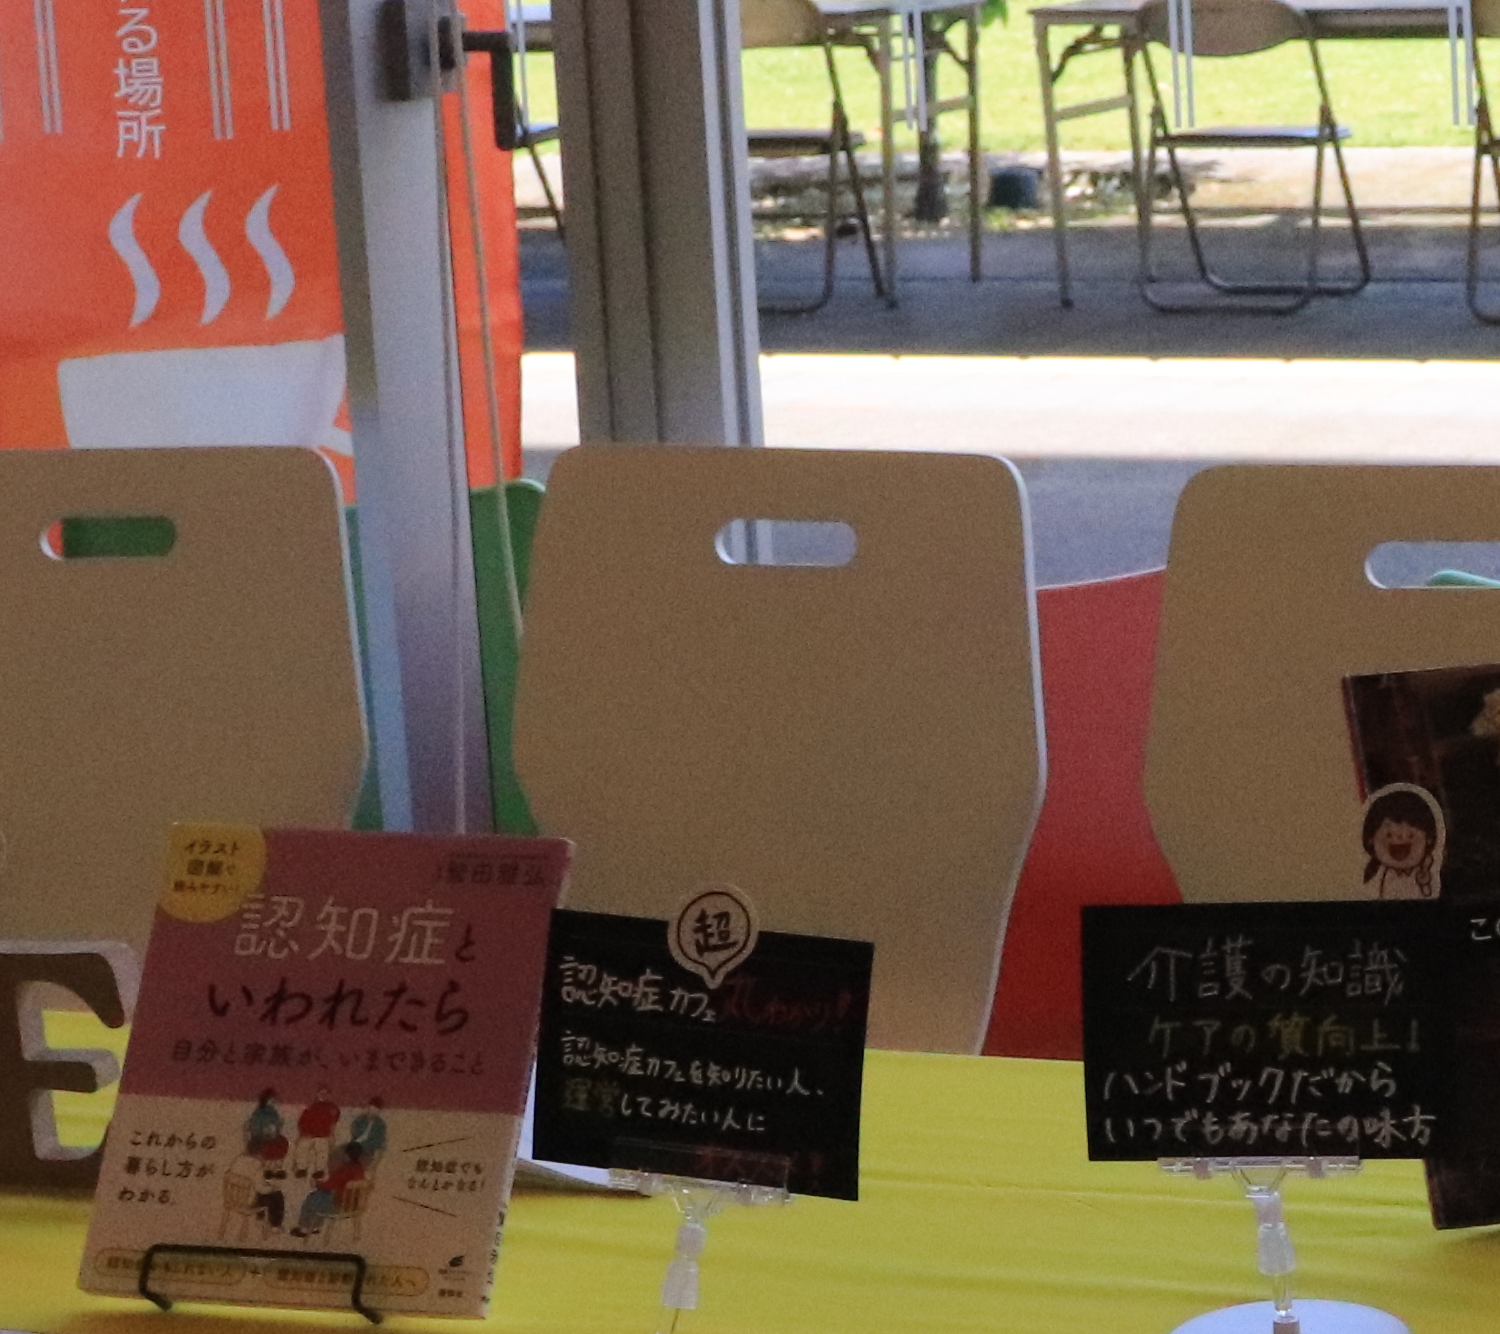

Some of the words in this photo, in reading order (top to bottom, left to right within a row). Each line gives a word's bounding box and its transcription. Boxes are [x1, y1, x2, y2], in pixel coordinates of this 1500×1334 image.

[233, 893, 477, 966] 認知症と
[692, 908, 739, 957] 超
[1125, 933, 1410, 1006] 介護の知識
[206, 975, 469, 1036] いわれたら
[1103, 1060, 1398, 1106] ハンドブックだから
[1103, 1104, 1438, 1149] いつでもあなたの味方
